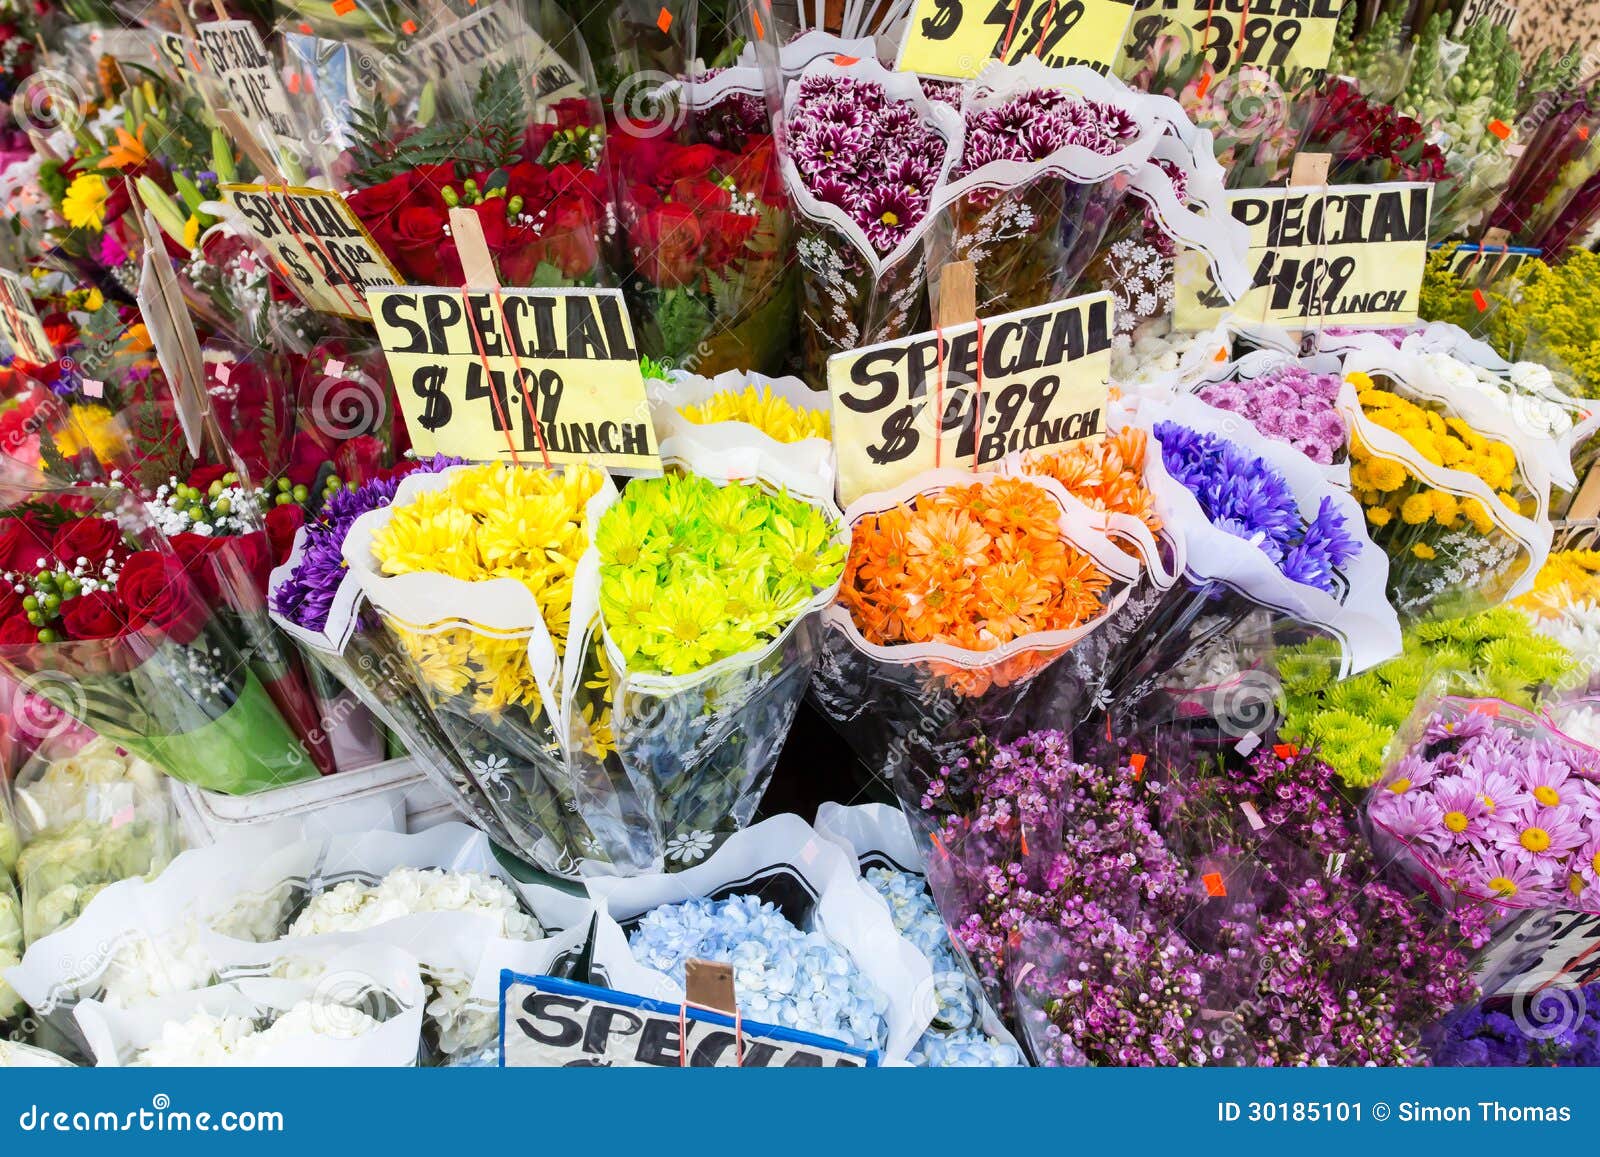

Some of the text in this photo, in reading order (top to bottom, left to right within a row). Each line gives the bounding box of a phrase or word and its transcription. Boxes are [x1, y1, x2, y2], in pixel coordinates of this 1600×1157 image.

[983, 0, 1085, 66] 4.99
[1192, 16, 1301, 75] 3.99
[233, 191, 364, 239] SPECIAL
[1231, 188, 1428, 248] PECIAL
[1249, 250, 1356, 312] 4.99
[1298, 290, 1407, 317] BUNCH
[380, 293, 638, 361] SPECIAL
[839, 300, 1112, 414] SPECIAL
[412, 361, 564, 433] $ 4.99
[866, 374, 1060, 466] $ 4.99
[523, 419, 650, 456] BUNCH
[976, 408, 1100, 466] BUNCH
